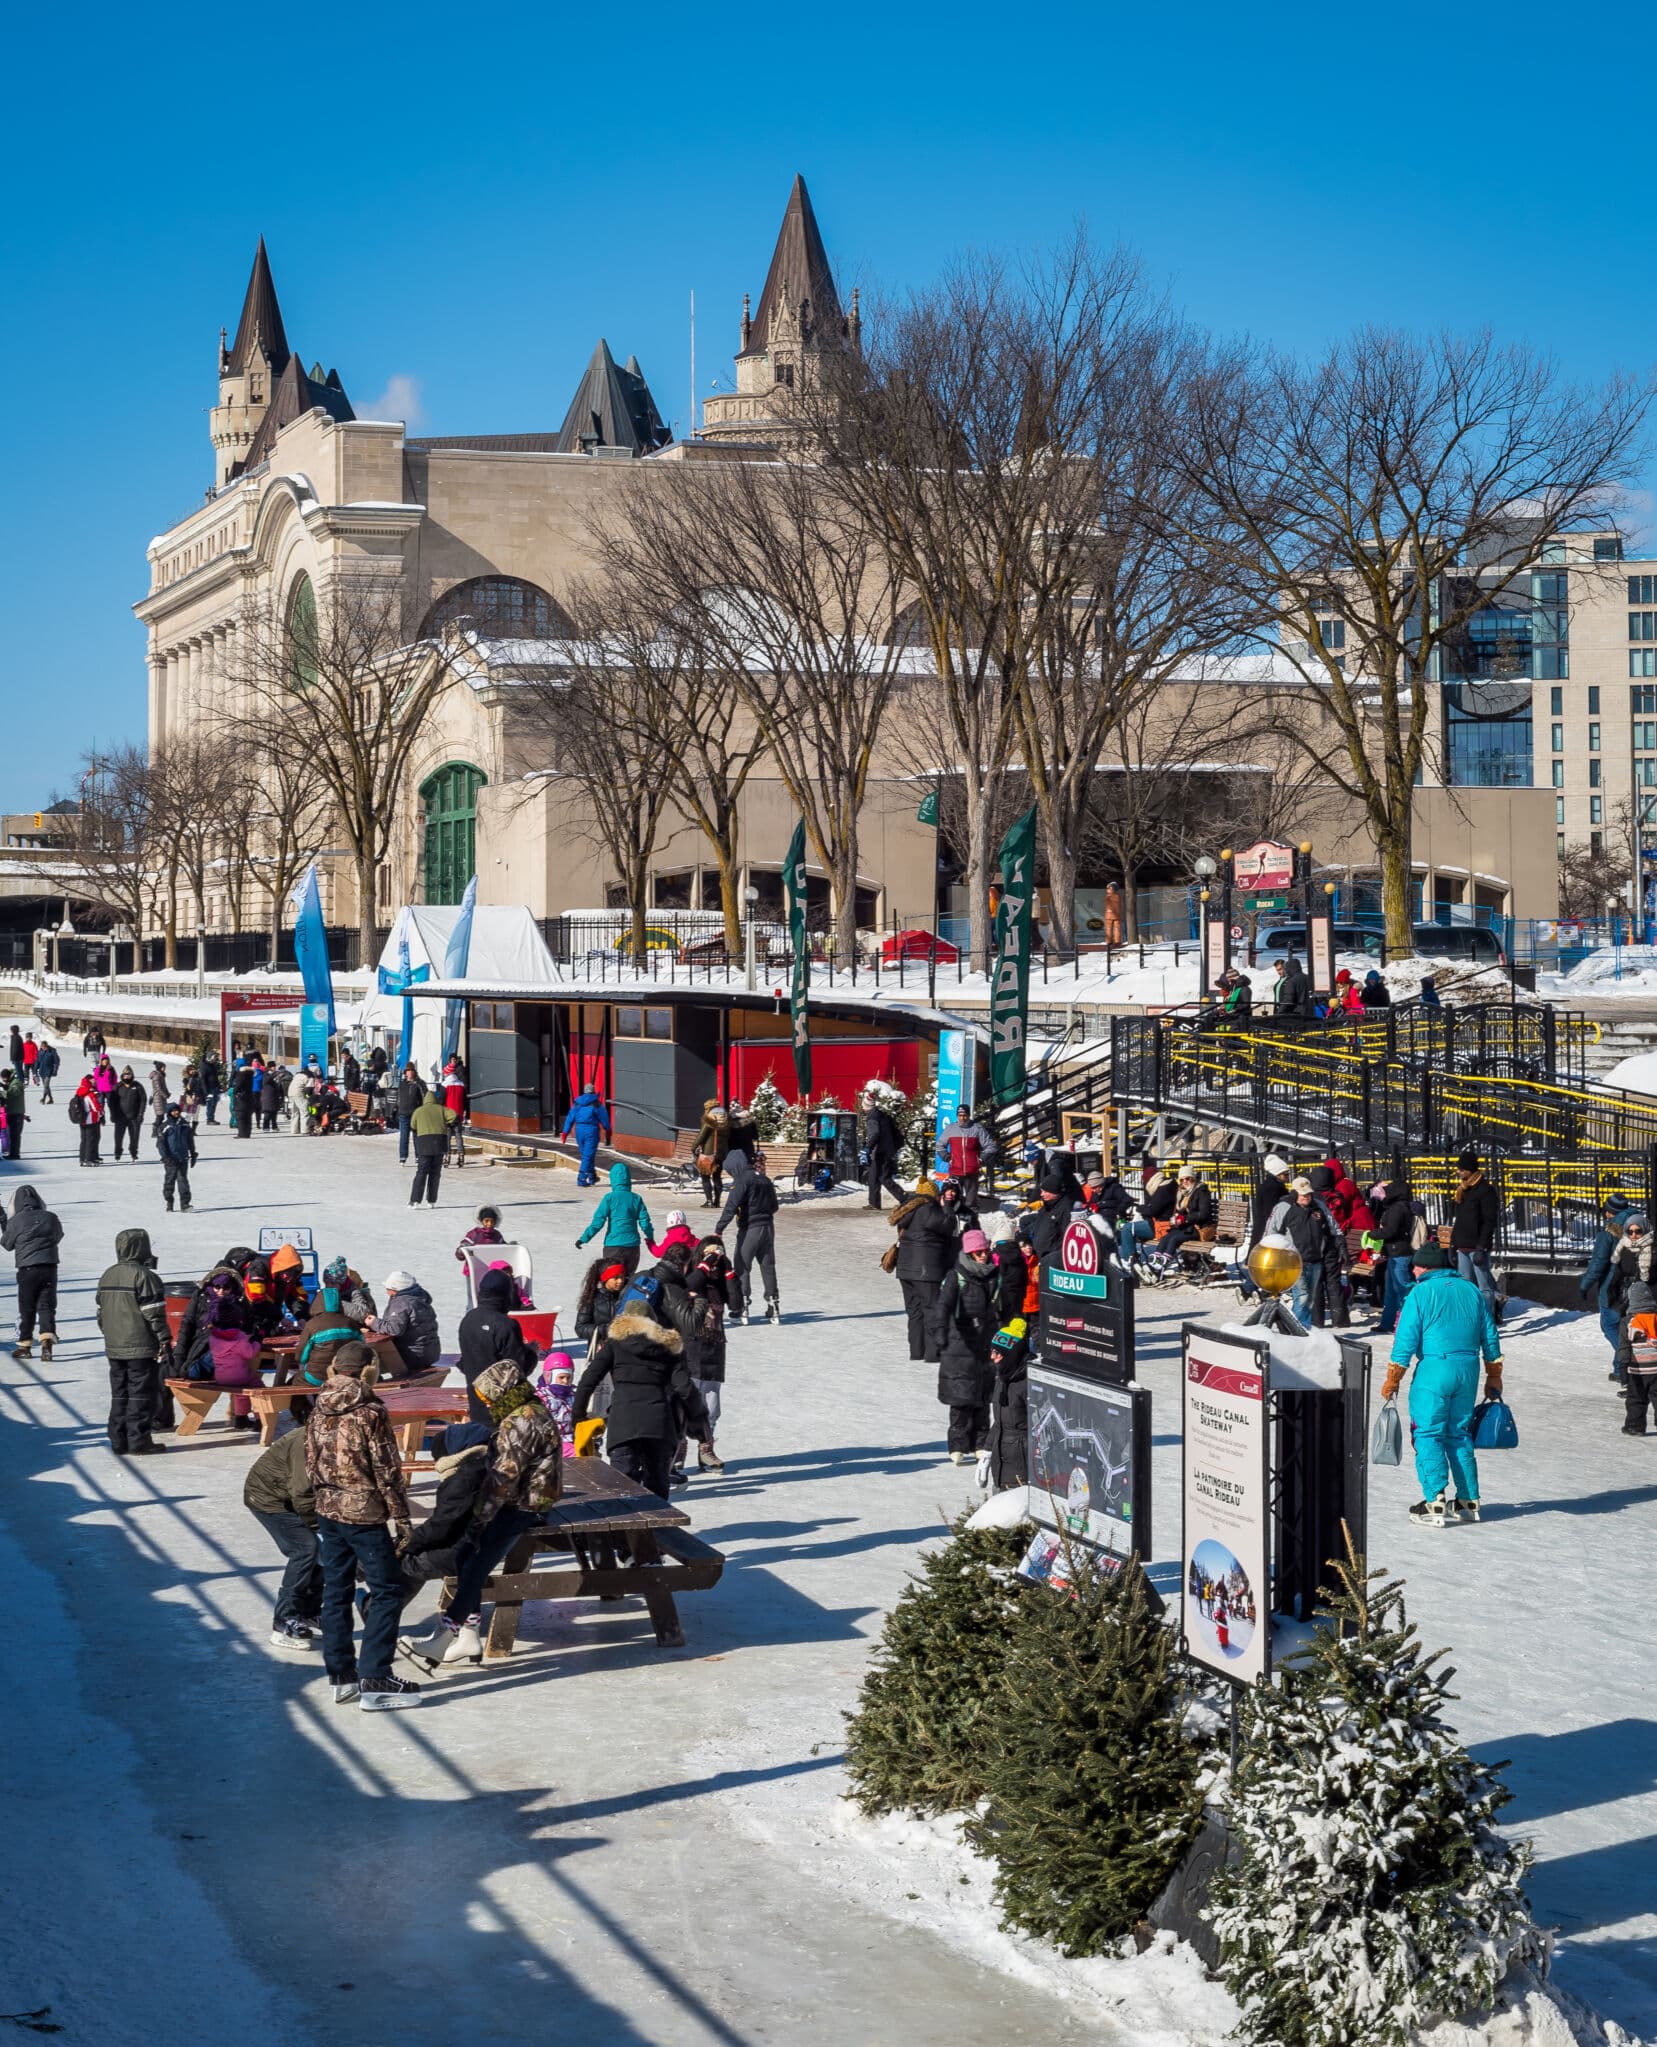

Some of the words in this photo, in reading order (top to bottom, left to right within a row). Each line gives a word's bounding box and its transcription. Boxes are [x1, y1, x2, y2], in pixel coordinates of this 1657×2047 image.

[1075, 1226, 1086, 1239] KM
[1067, 1238, 1093, 1271] 0.0
[1053, 1274, 1084, 1291] RIDEAU
[1191, 1397, 1200, 1410] THE
[1201, 1402, 1222, 1418] RIDEAU
[1224, 1409, 1250, 1425] CANAL
[1200, 1414, 1232, 1434] SKATEWAY
[1196, 1482, 1214, 1498] CANAL
[1214, 1488, 1240, 1507] RIDEAU
[1201, 1472, 1232, 1491] PATINOIRE
[1234, 1484, 1245, 1495] DU
